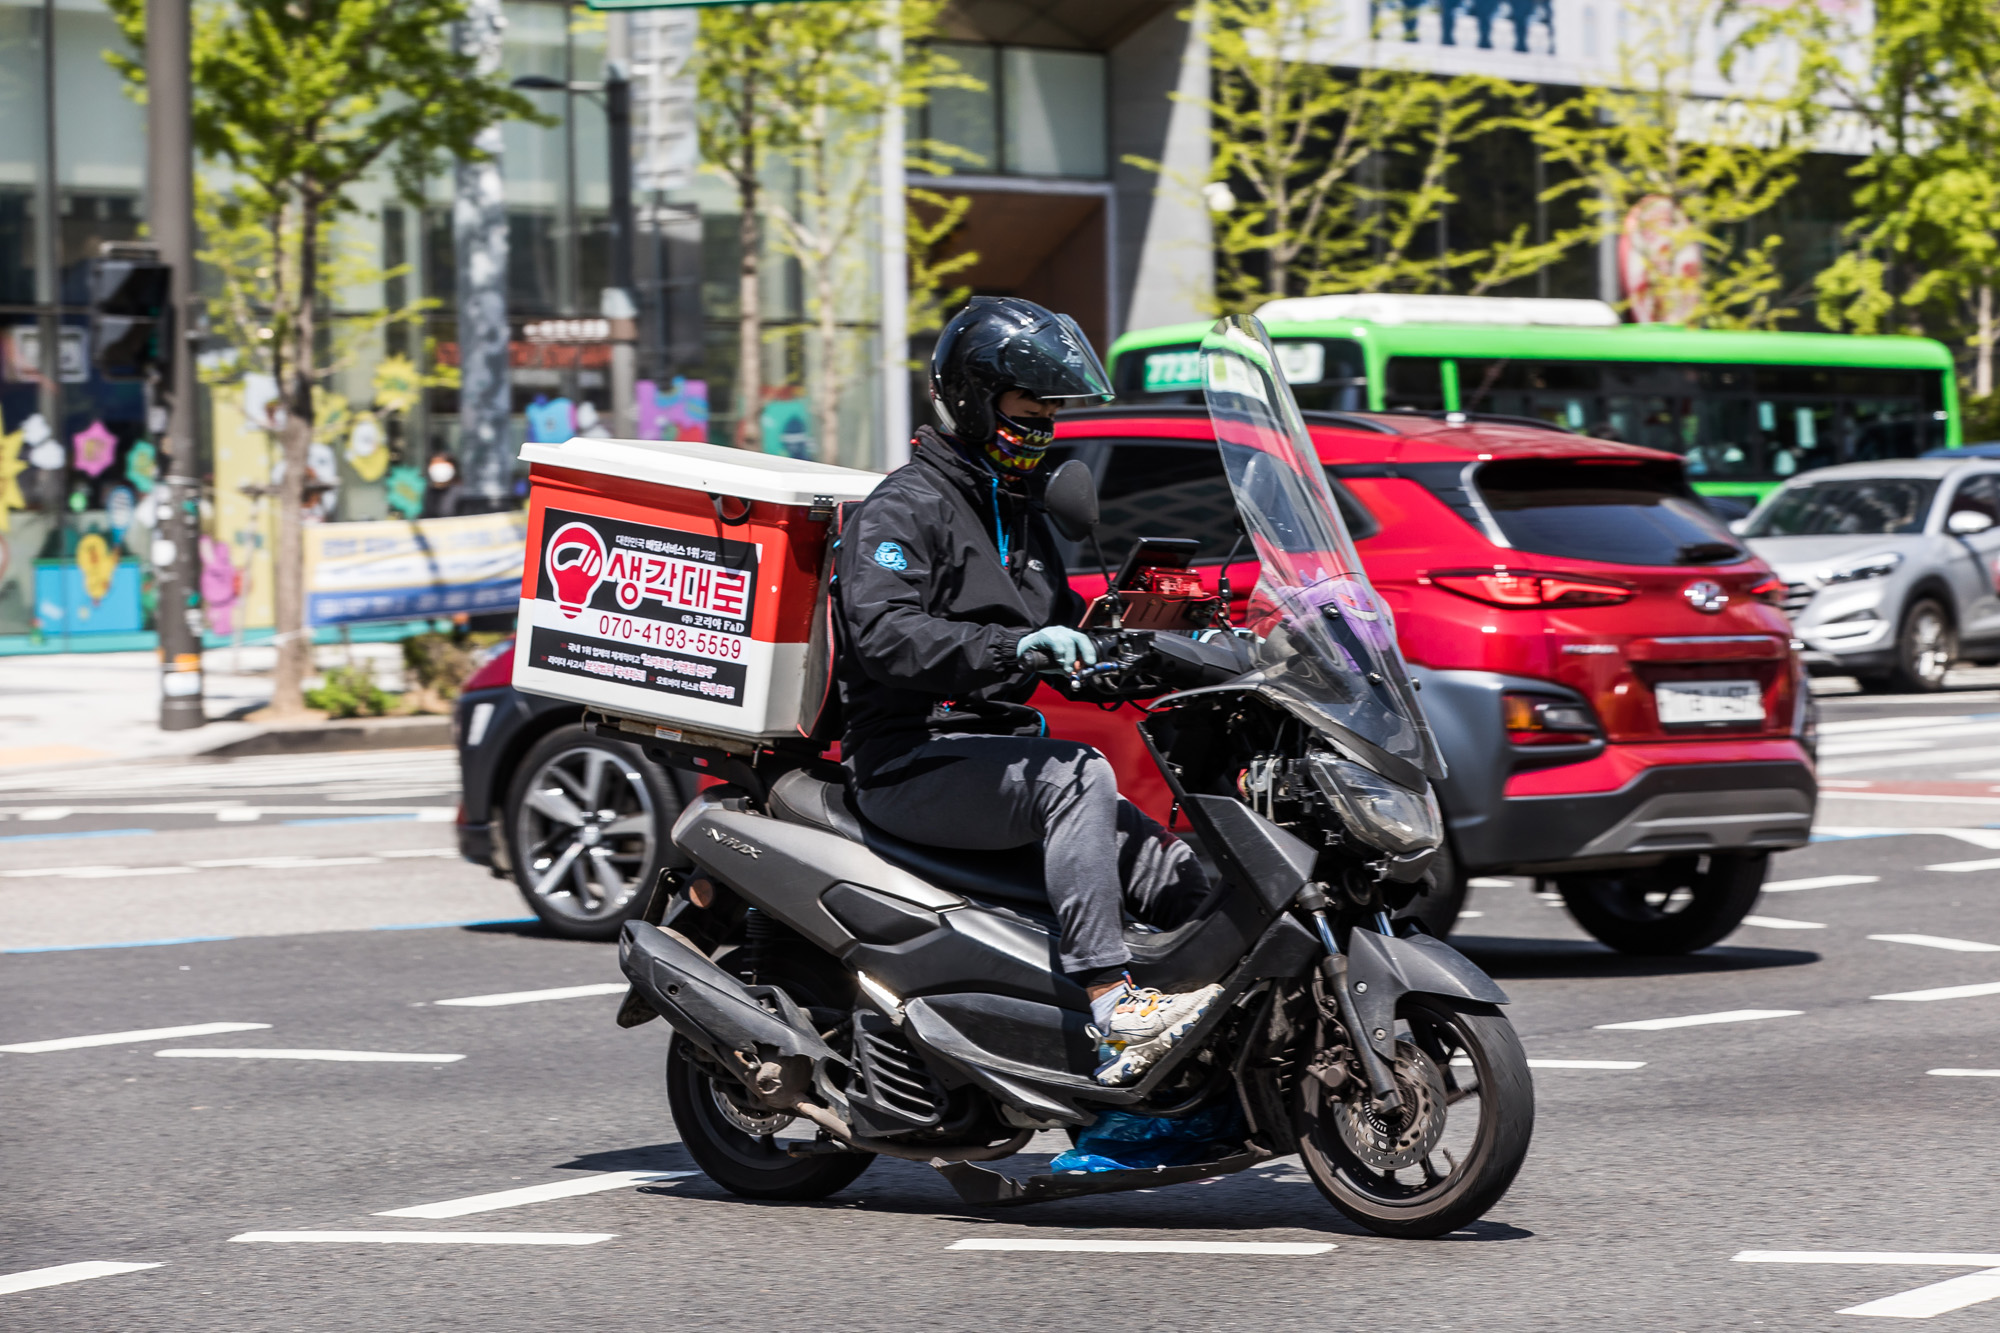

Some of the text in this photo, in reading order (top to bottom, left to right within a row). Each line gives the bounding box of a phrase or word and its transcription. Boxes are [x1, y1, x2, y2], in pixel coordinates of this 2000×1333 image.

[615, 535, 717, 562] 대한민국 배달서비스 1위 기업
[606, 551, 748, 617] 생각대로
[693, 615, 723, 630] 코리아
[723, 621, 745, 633] F&D
[599, 615, 742, 659] 070-4193-5559
[568, 642, 581, 654] 국내
[547, 655, 567, 667] 라이더
[567, 659, 585, 670] 사고시
[655, 675, 681, 689] 오토바이
